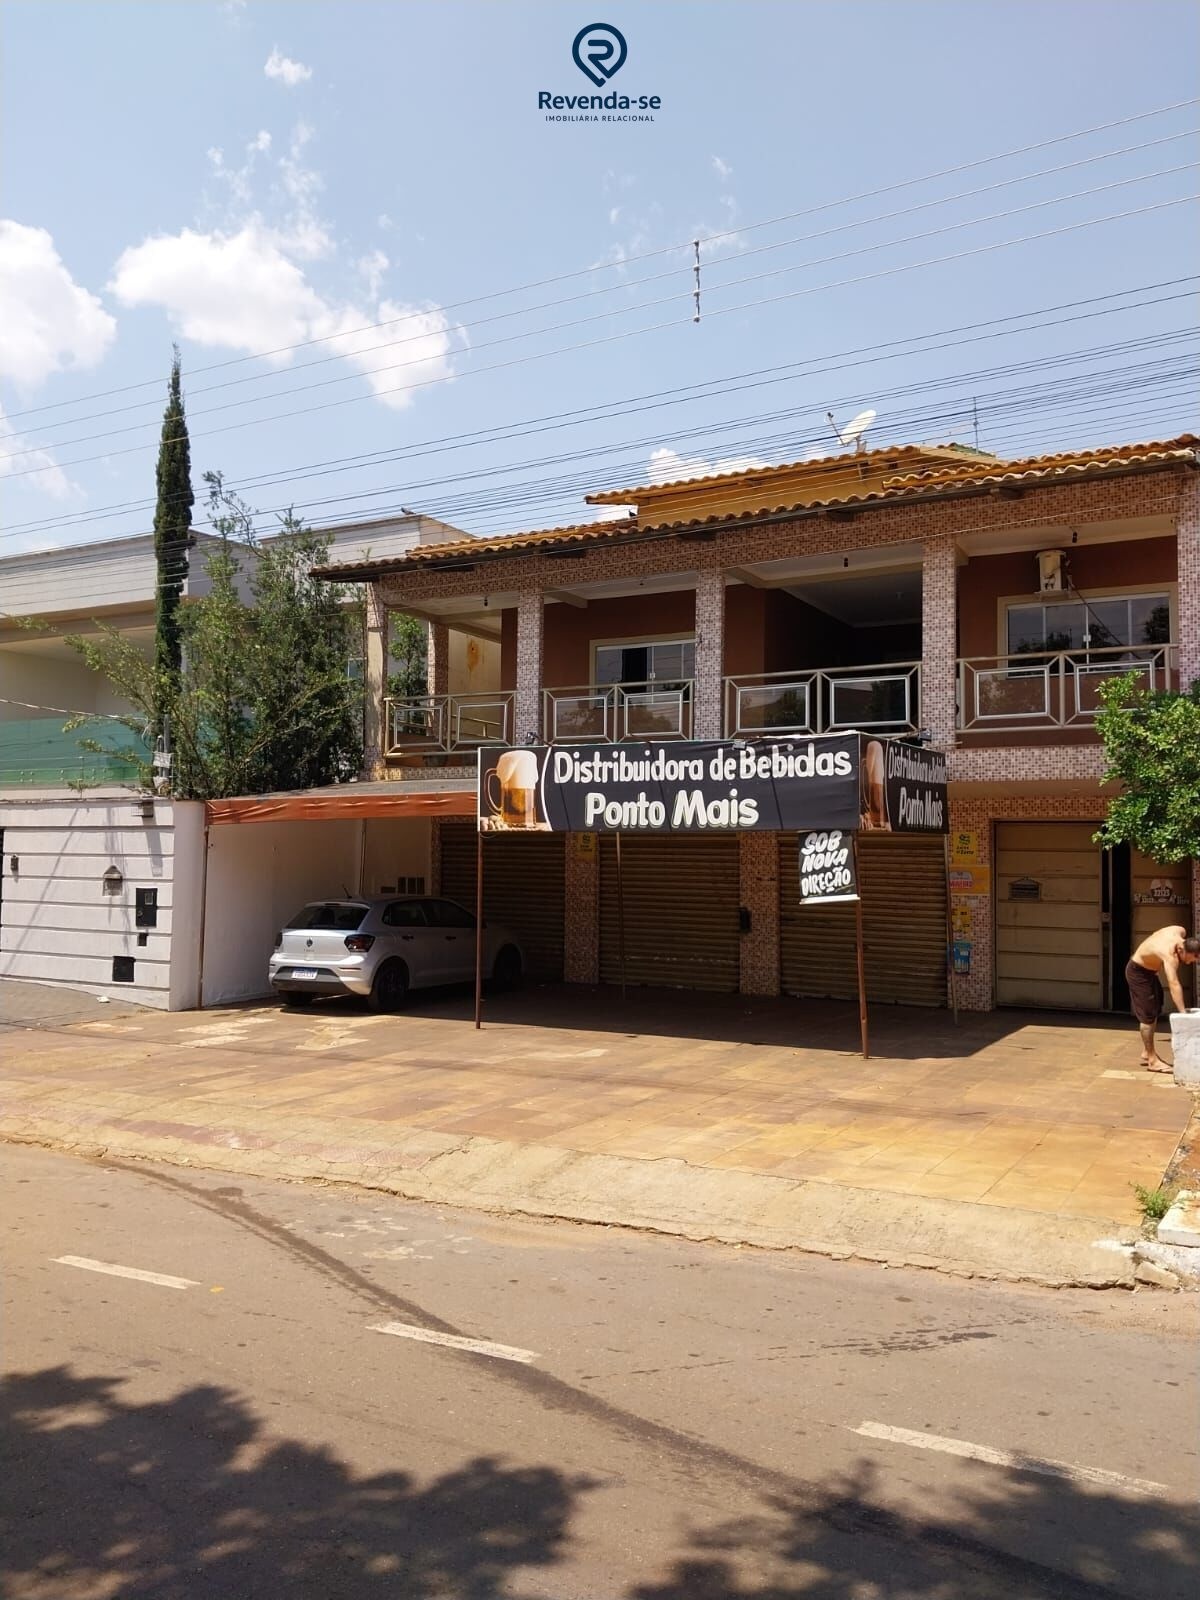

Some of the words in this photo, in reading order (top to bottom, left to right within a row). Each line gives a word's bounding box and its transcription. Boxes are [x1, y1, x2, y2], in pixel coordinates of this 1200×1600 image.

[553, 748, 704, 785] Distribuidora
[709, 748, 737, 781] de
[739, 743, 852, 780] Bebidas
[585, 791, 666, 829] Ponto
[671, 788, 760, 829] Mais
[898, 786, 924, 826] Ponto
[924, 790, 943, 828] Mais
[801, 830, 843, 855] SOB
[801, 848, 849, 873] NOVA
[801, 866, 851, 896] DIREÇÃO
